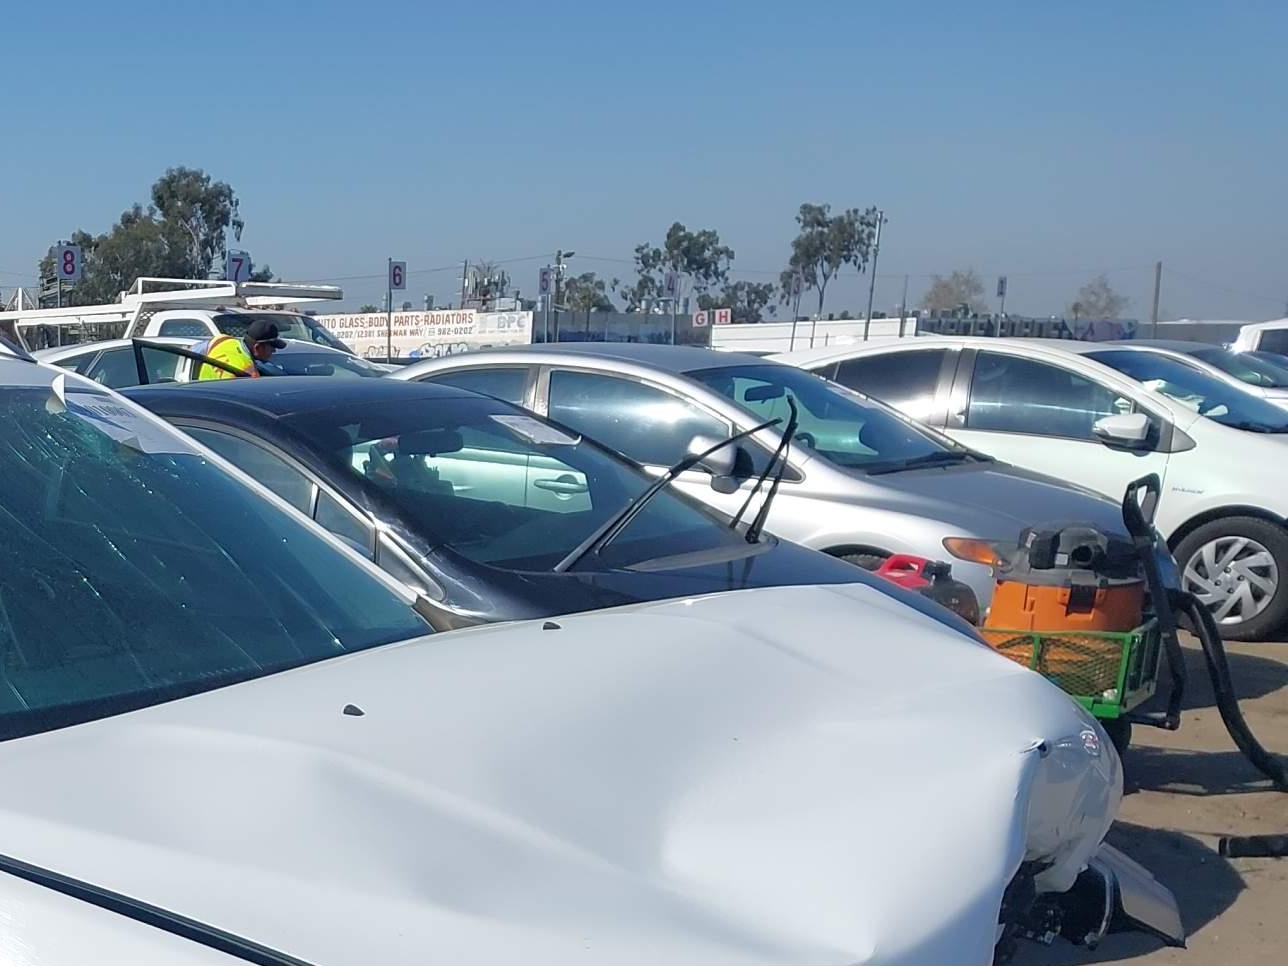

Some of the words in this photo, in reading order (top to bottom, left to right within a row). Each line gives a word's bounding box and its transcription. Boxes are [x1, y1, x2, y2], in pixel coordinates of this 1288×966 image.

[63, 250, 75, 275] 8
[232, 257, 243, 281] 7
[393, 265, 402, 286] 6
[542, 271, 549, 291] 5
[319, 318, 336, 329] UTO
[695, 313, 705, 325] G
[719, 310, 728, 323] H
